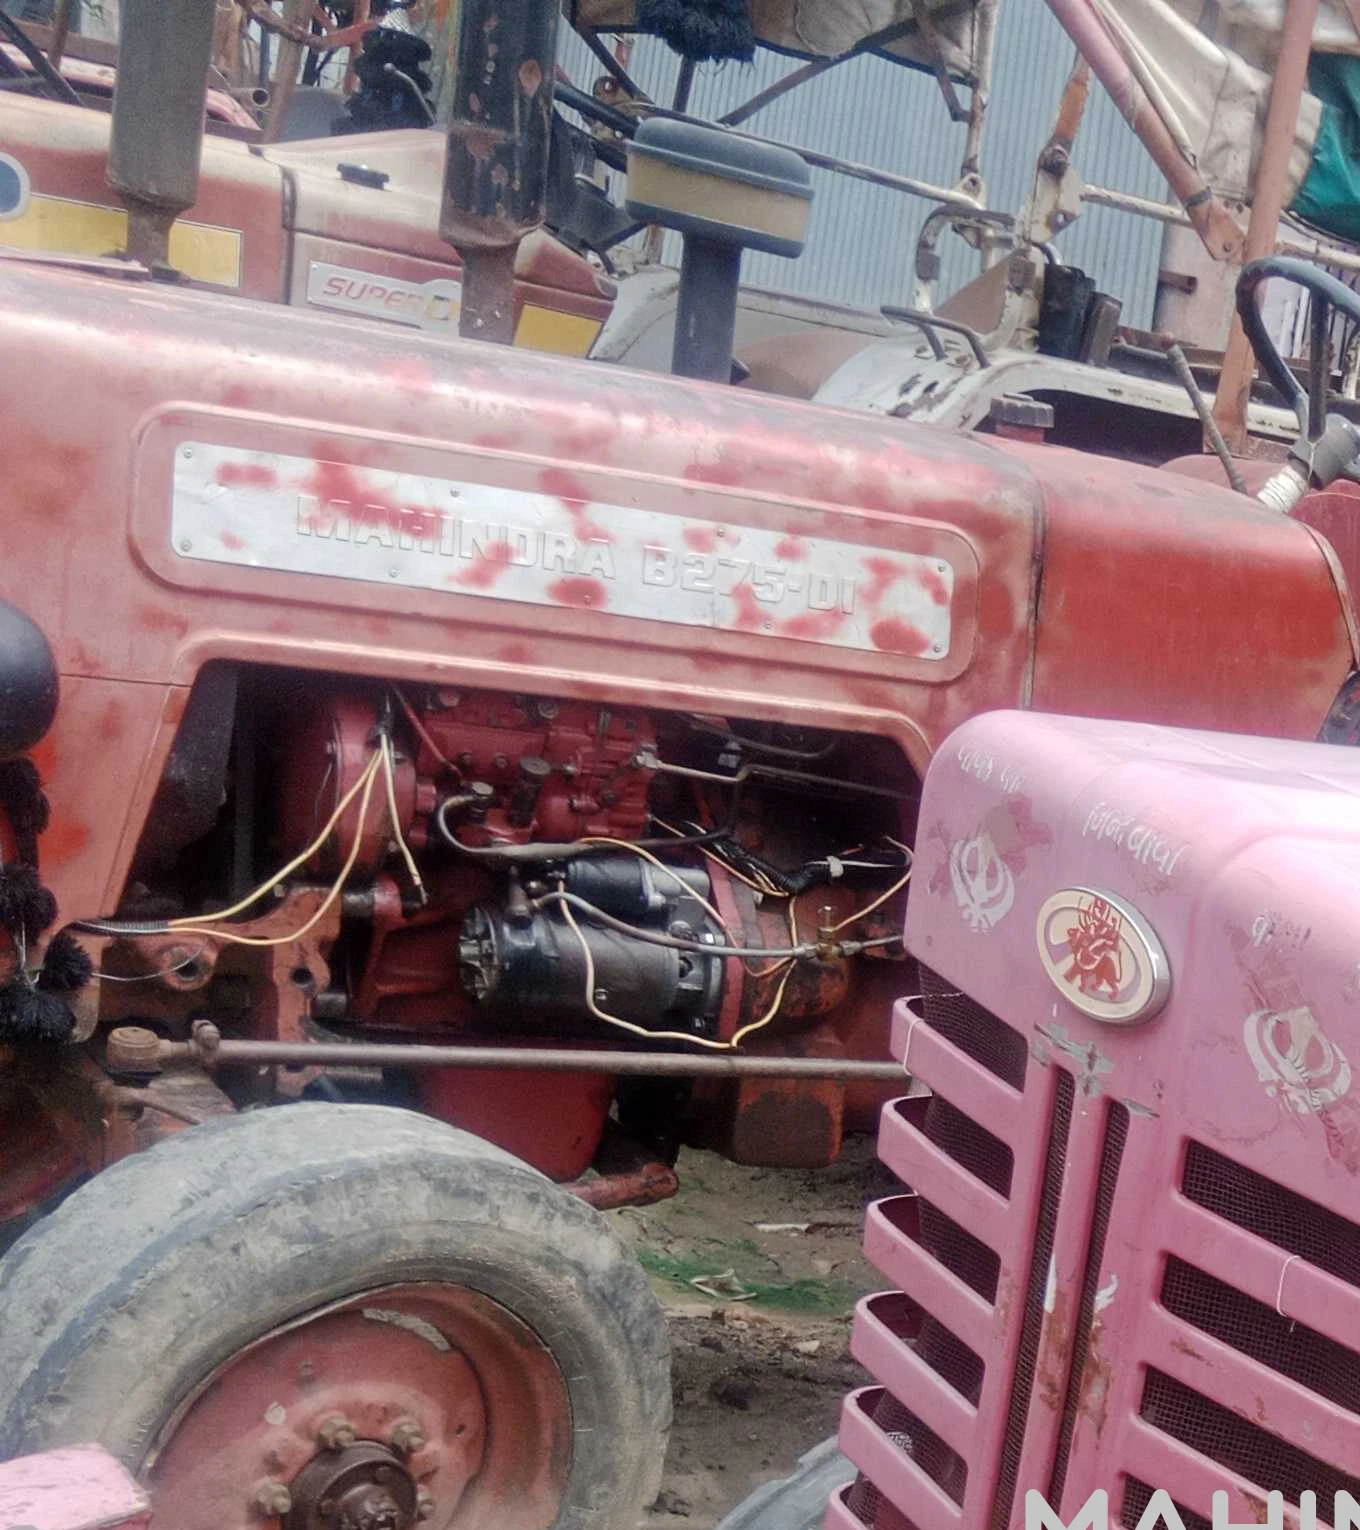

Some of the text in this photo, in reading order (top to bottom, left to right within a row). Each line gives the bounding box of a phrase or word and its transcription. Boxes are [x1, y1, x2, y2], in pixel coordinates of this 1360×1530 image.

[322, 275, 426, 312] SUPER
[296, 495, 856, 616] MAHINDRA B275-DI
